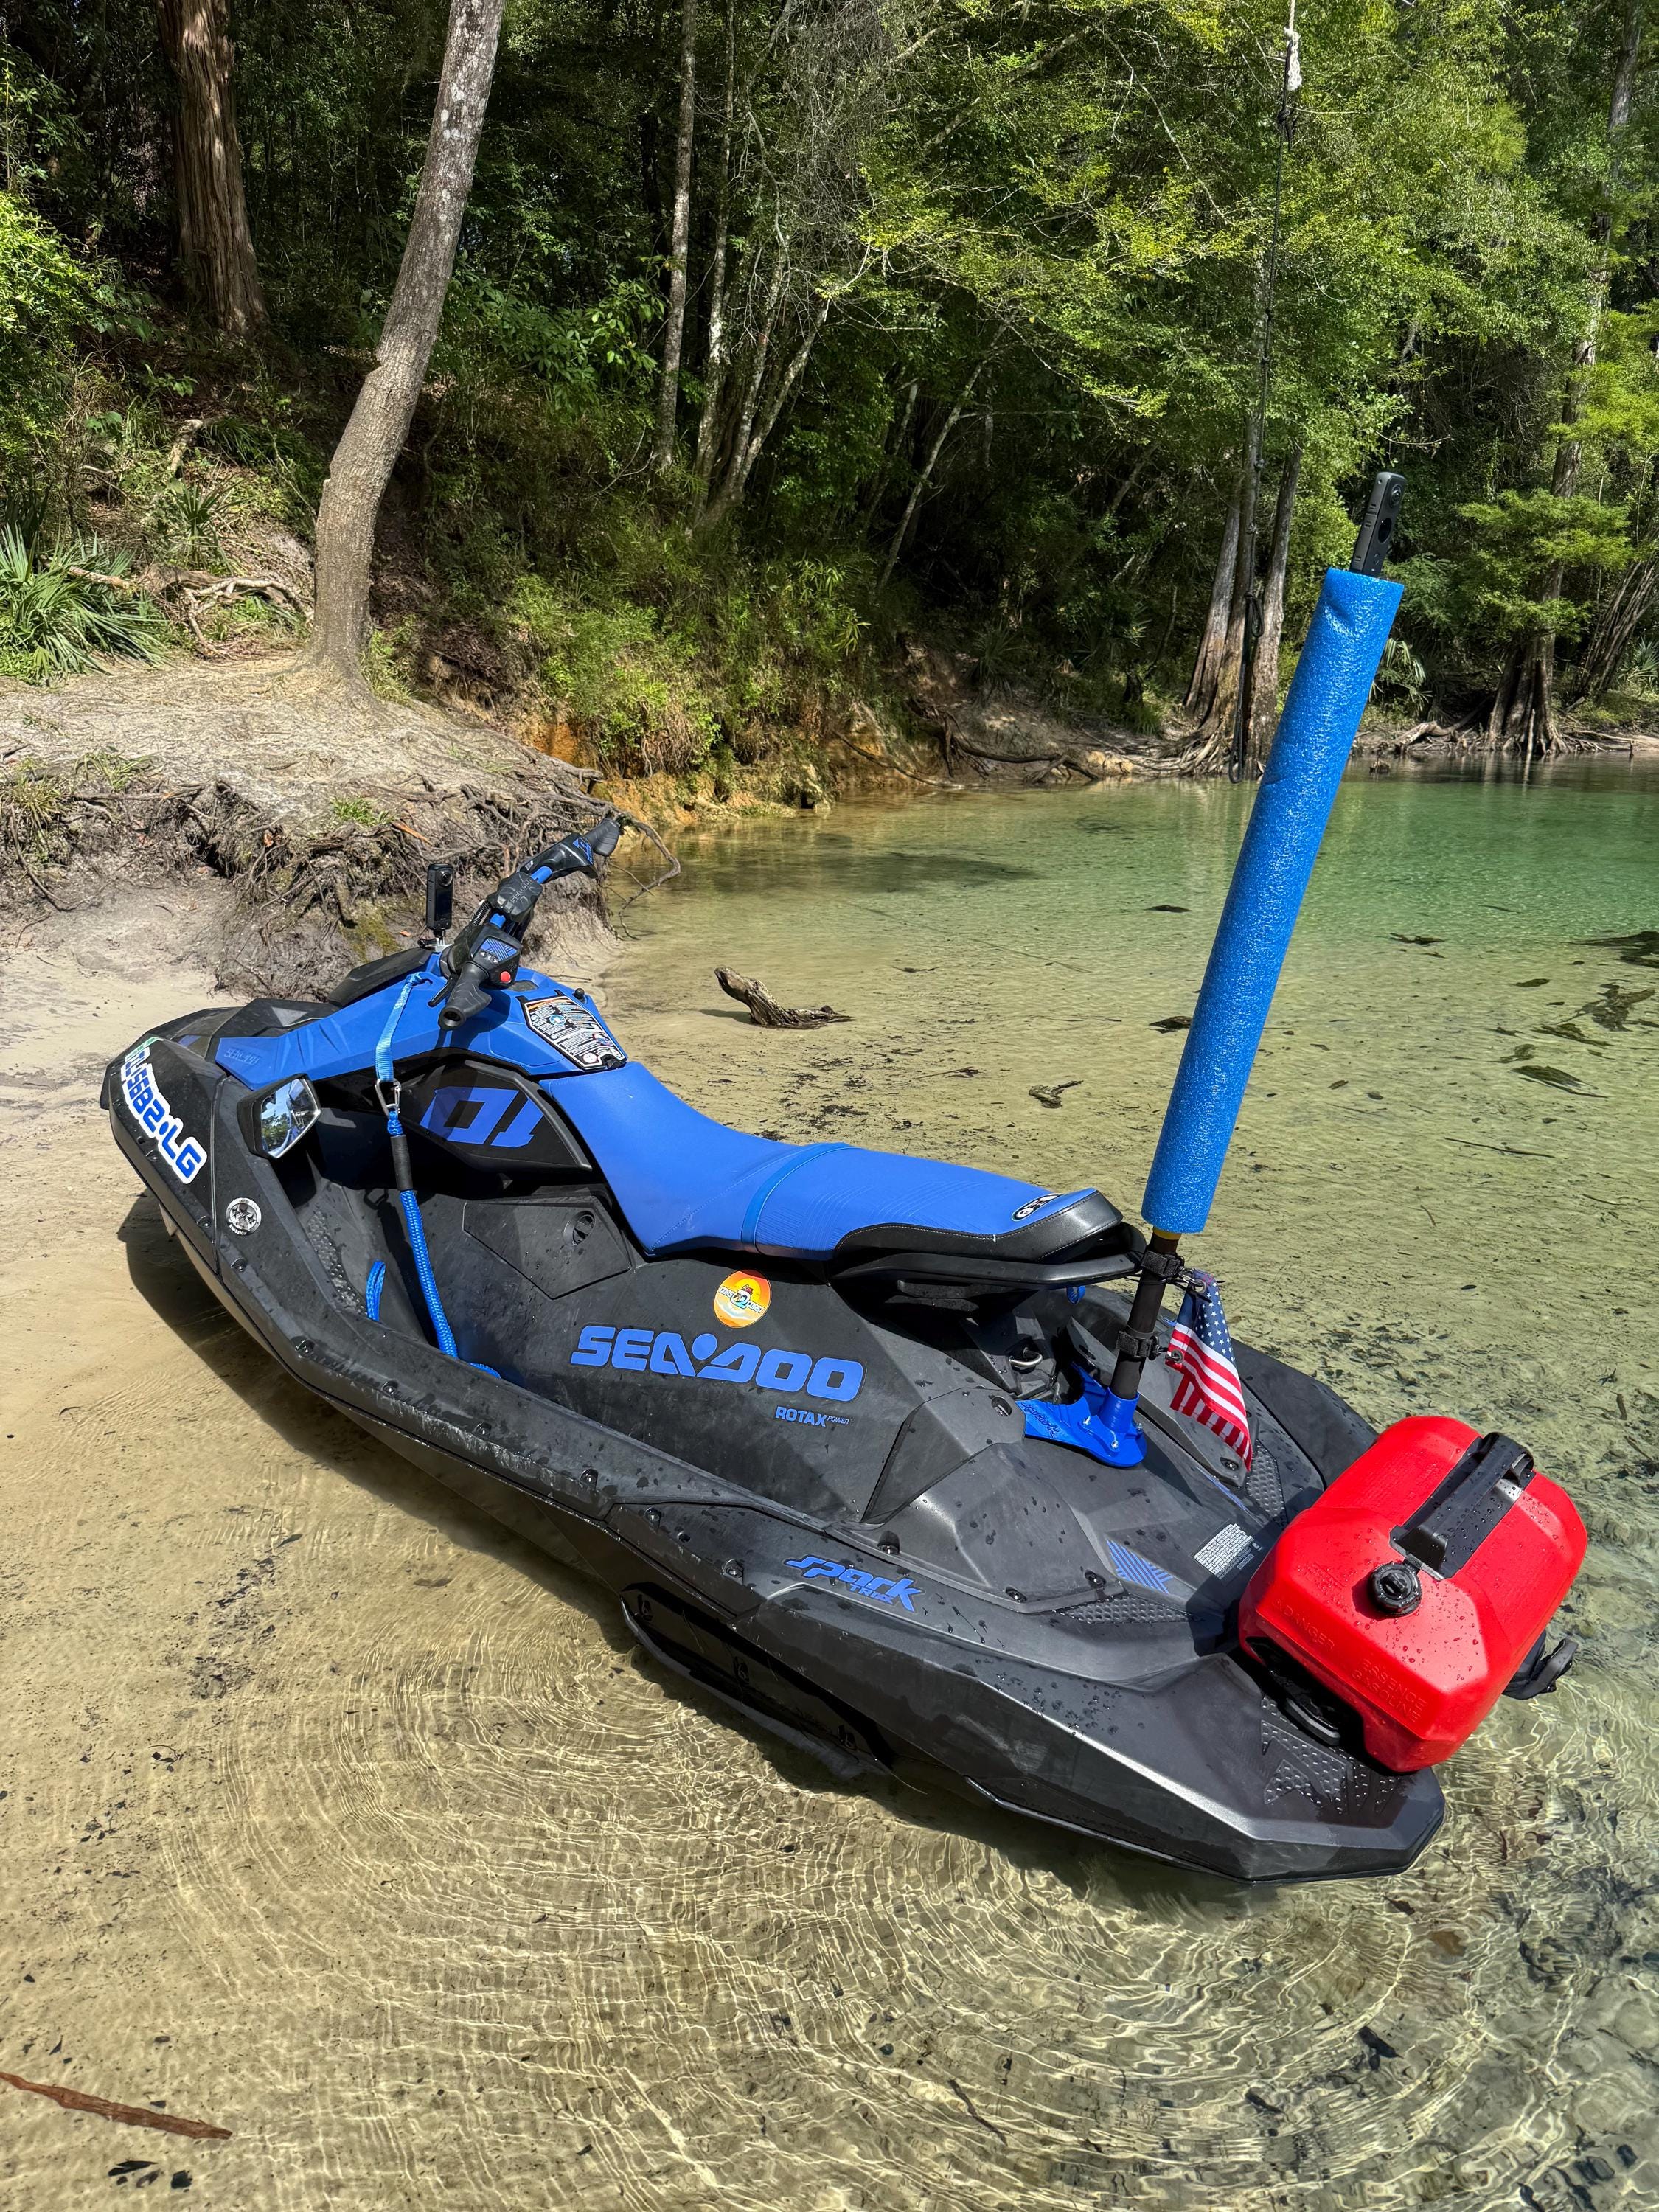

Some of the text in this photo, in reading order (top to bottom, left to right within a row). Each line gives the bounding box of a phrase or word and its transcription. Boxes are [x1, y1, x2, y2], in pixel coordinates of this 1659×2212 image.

[775, 1406, 850, 1427] ROTAX POWER
[1283, 1604, 1335, 1649] DANGER
[1351, 1669, 1422, 1723] GASOLINE
[1363, 1659, 1427, 1709] ESSENCE
